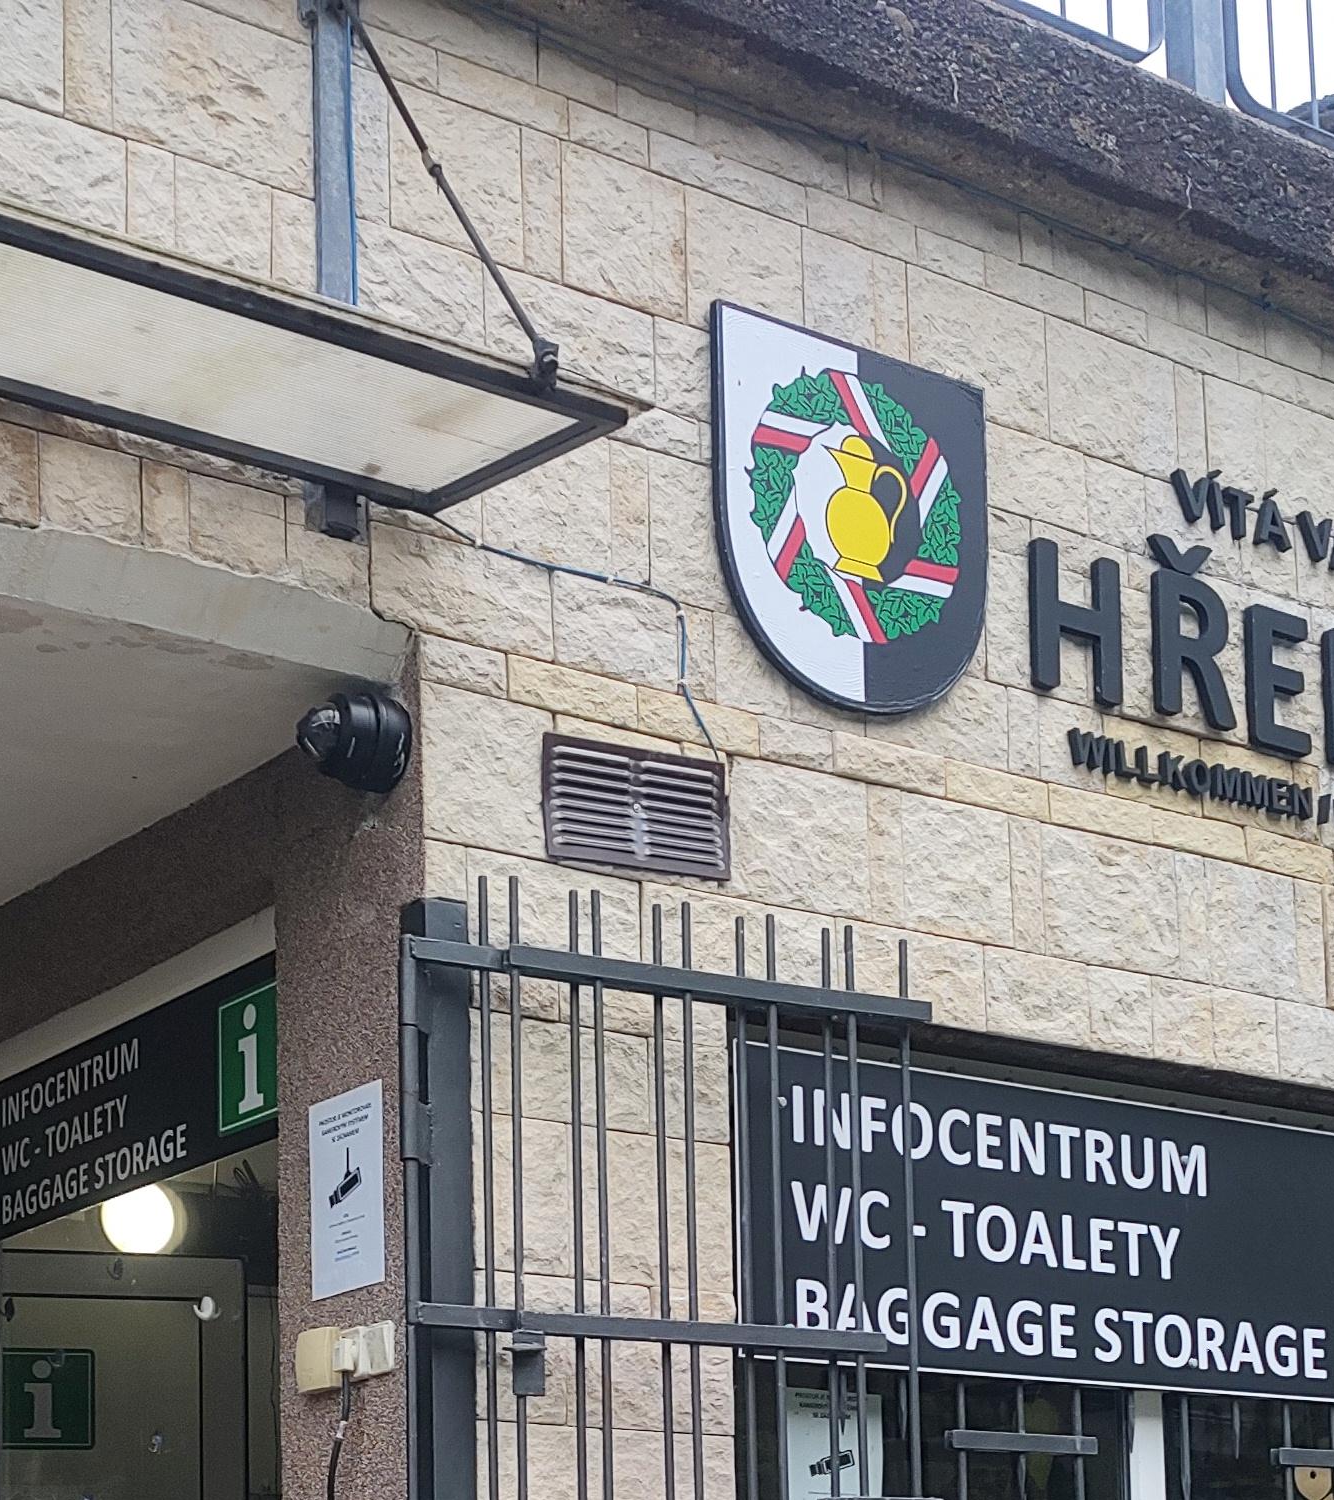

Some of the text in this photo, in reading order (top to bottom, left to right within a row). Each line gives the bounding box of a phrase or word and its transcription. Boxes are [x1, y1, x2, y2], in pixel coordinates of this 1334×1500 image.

[1169, 467, 1293, 553] VÍTÁ
[1067, 727, 1315, 821] WILLKOMMEN
[1, 1037, 140, 1129] INFOCENTRUM
[1, 1136, 31, 1176] WC
[44, 1094, 129, 1158] TOALETY
[1, 1123, 188, 1225] BAGGAGE STORAGE
[791, 1084, 1208, 1198] INFOCENTRUM
[790, 1180, 892, 1250] WC
[940, 1199, 1182, 1281] TOALETY
[794, 1277, 1328, 1381] BAGGAGE STORAGE
